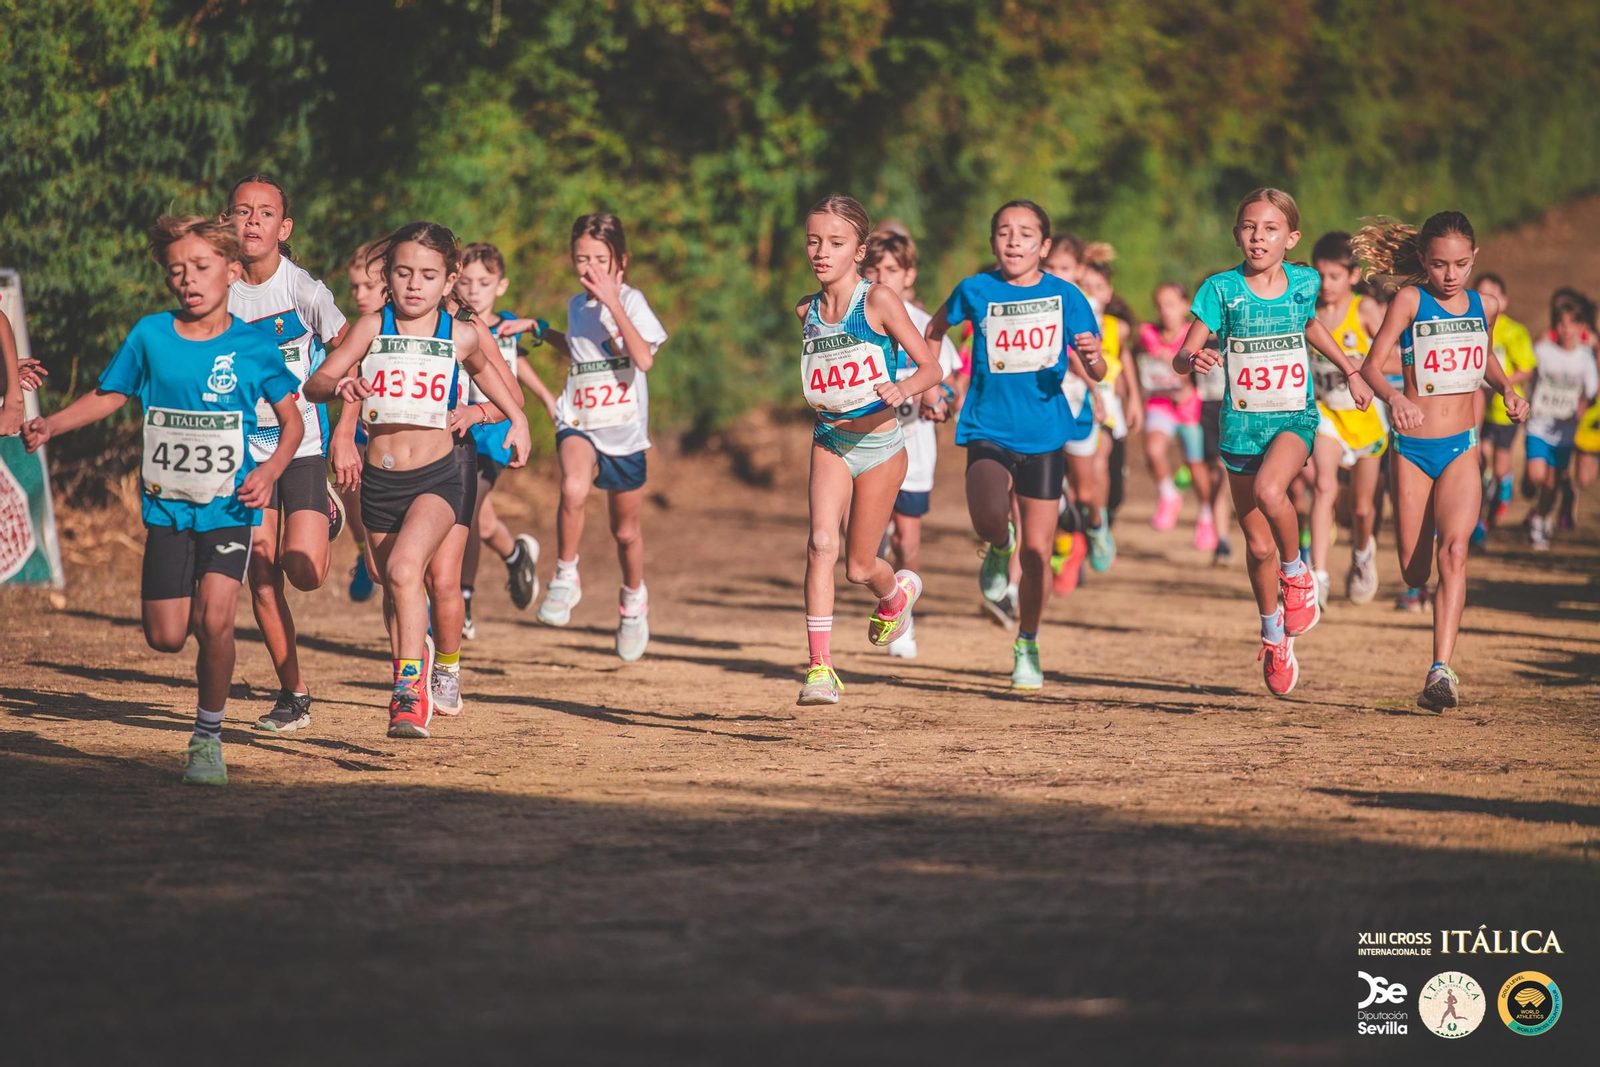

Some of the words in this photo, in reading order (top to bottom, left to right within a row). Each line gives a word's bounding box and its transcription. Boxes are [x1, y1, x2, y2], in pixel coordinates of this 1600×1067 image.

[1007, 302, 1042, 315] ITÁLICA
[995, 324, 1057, 352] 4407
[1435, 320, 1471, 333] ITÁLICA
[388, 337, 433, 353] ITÁLICA
[817, 335, 854, 350] ITÁLICA
[1249, 339, 1289, 351] ITÁLICA
[1424, 346, 1483, 373] 4370
[371, 370, 446, 402] 4356
[810, 355, 883, 394] 4421
[1237, 362, 1306, 391] 4379
[573, 381, 631, 410] 4522
[170, 413, 217, 428] ITÁLICA
[152, 442, 236, 474] 4233
